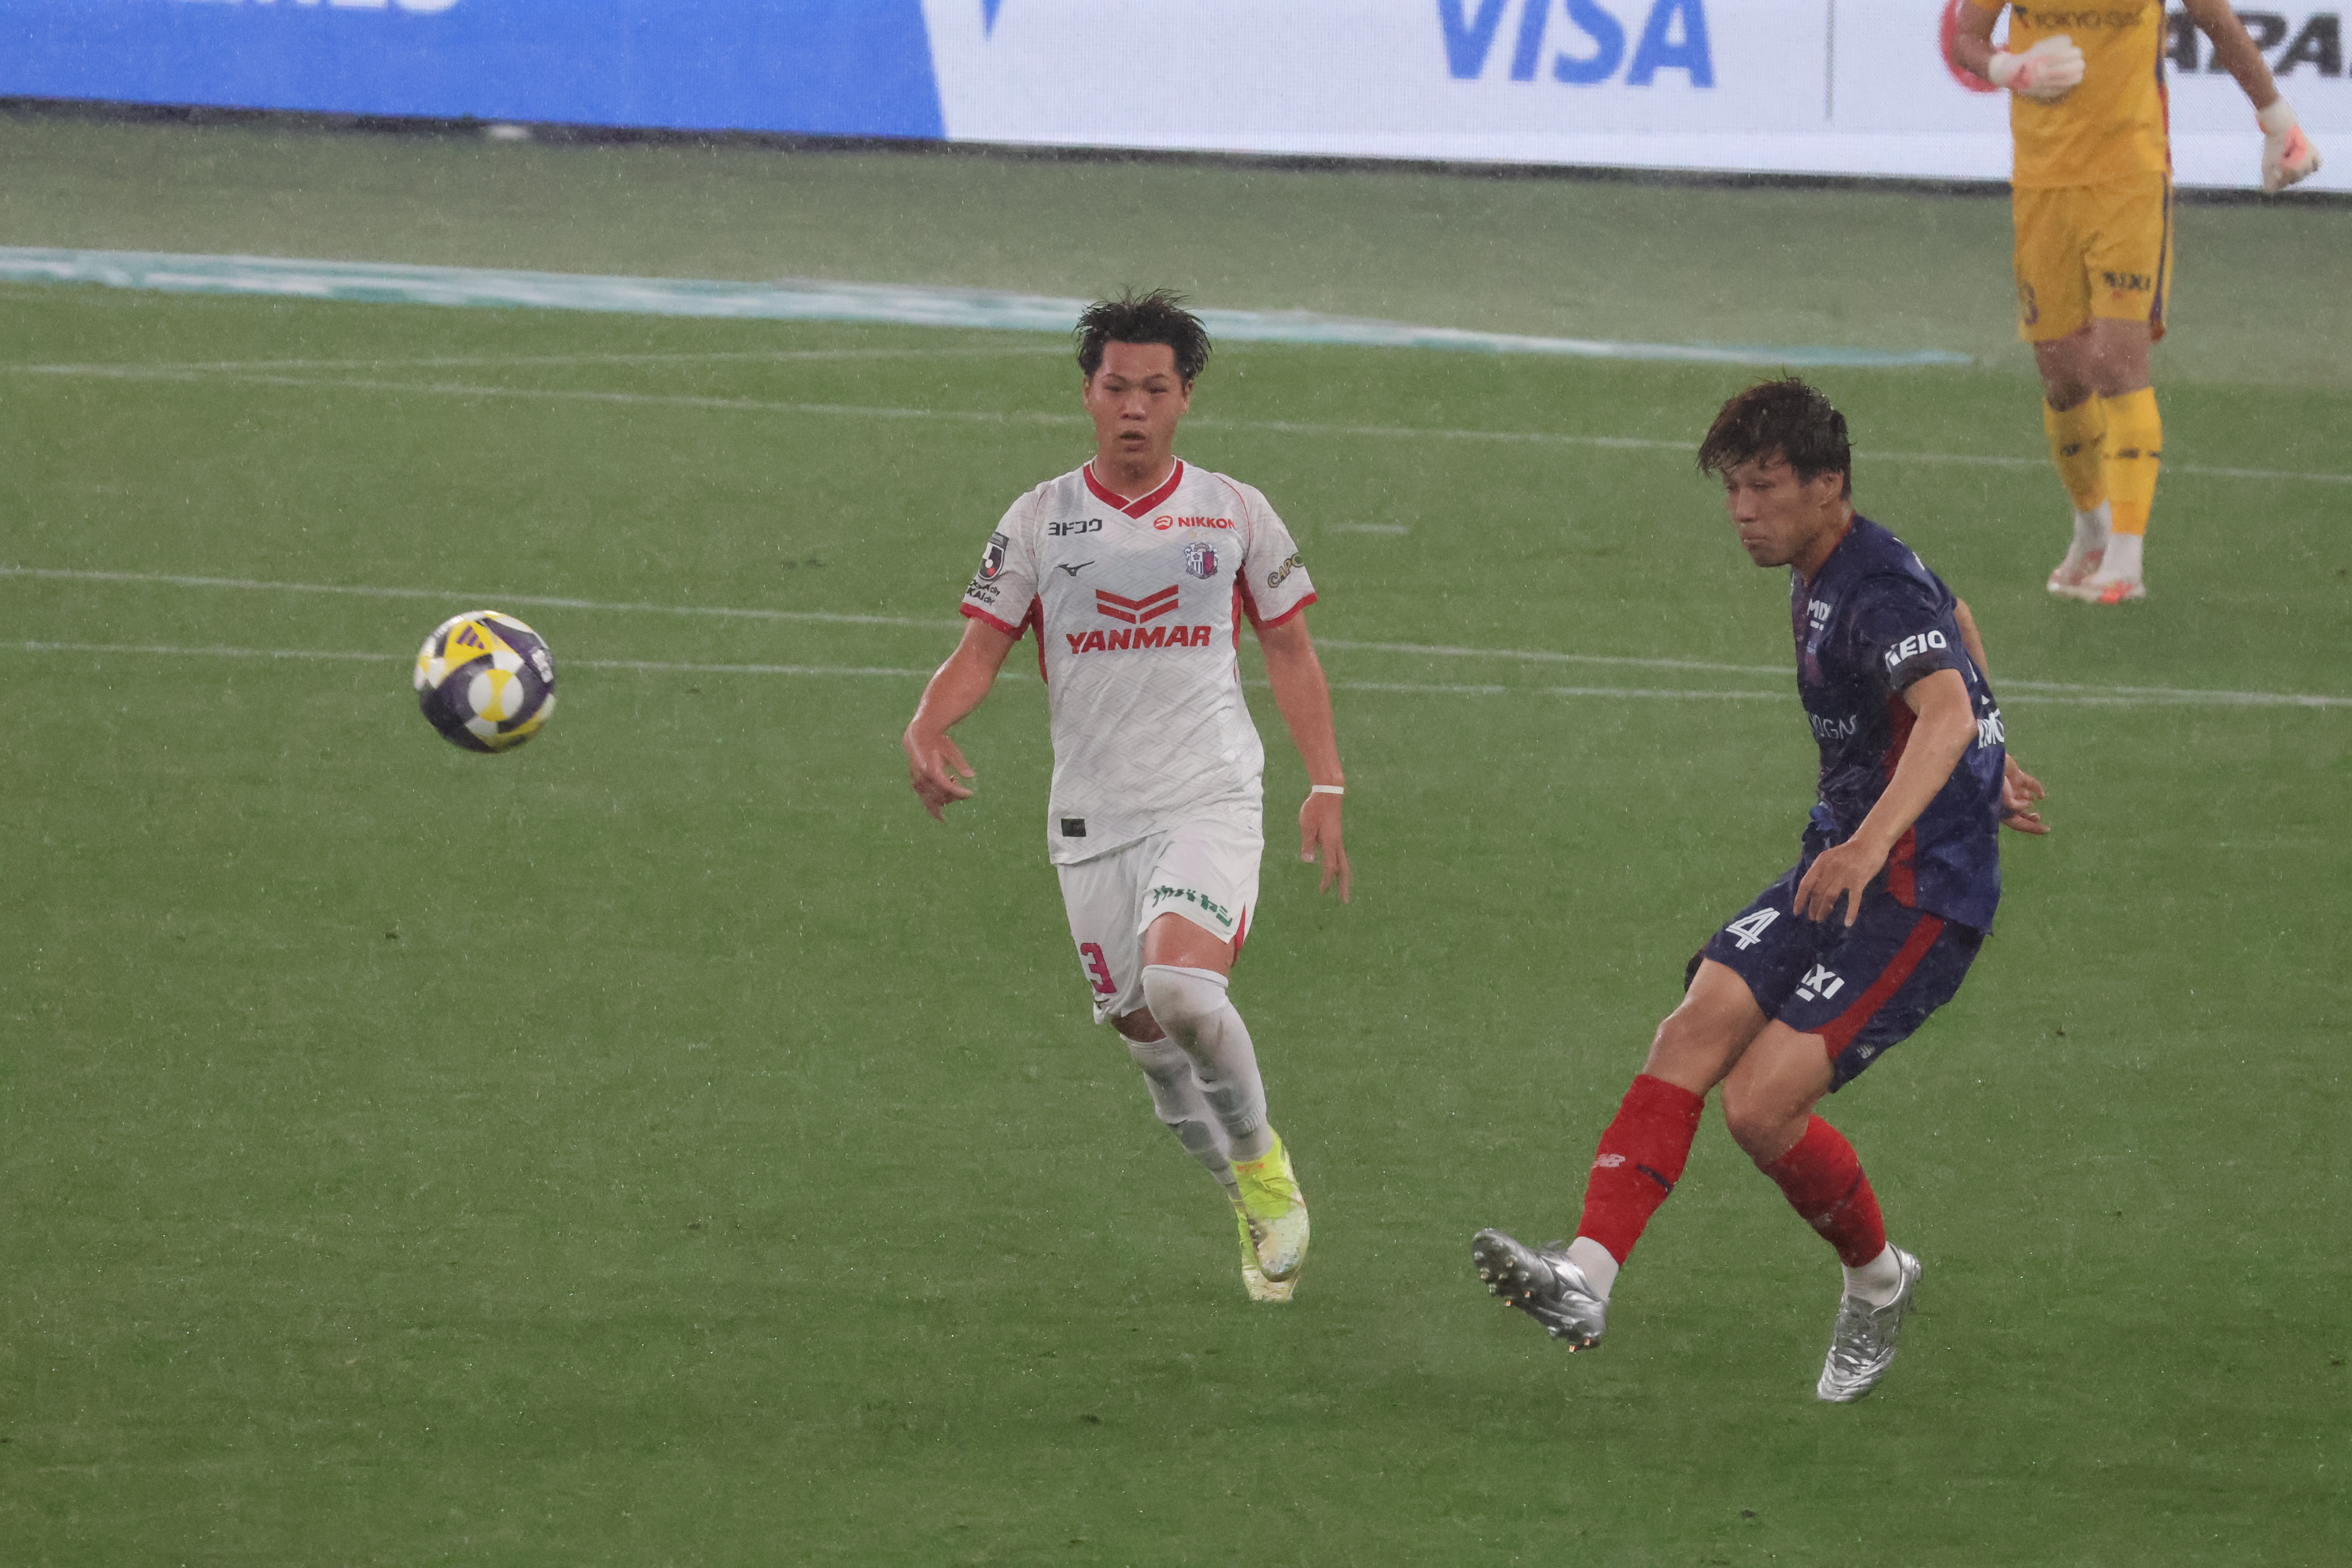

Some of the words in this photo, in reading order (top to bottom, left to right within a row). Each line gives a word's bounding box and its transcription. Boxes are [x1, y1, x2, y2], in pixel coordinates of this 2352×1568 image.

[1436, 0, 1714, 89] VISA
[2165, 13, 2352, 77] APA
[1178, 517, 1236, 530] NIKKON
[1066, 625, 1211, 654] YANMAR
[1725, 907, 1781, 950] 4
[1080, 942, 1118, 994] 3
